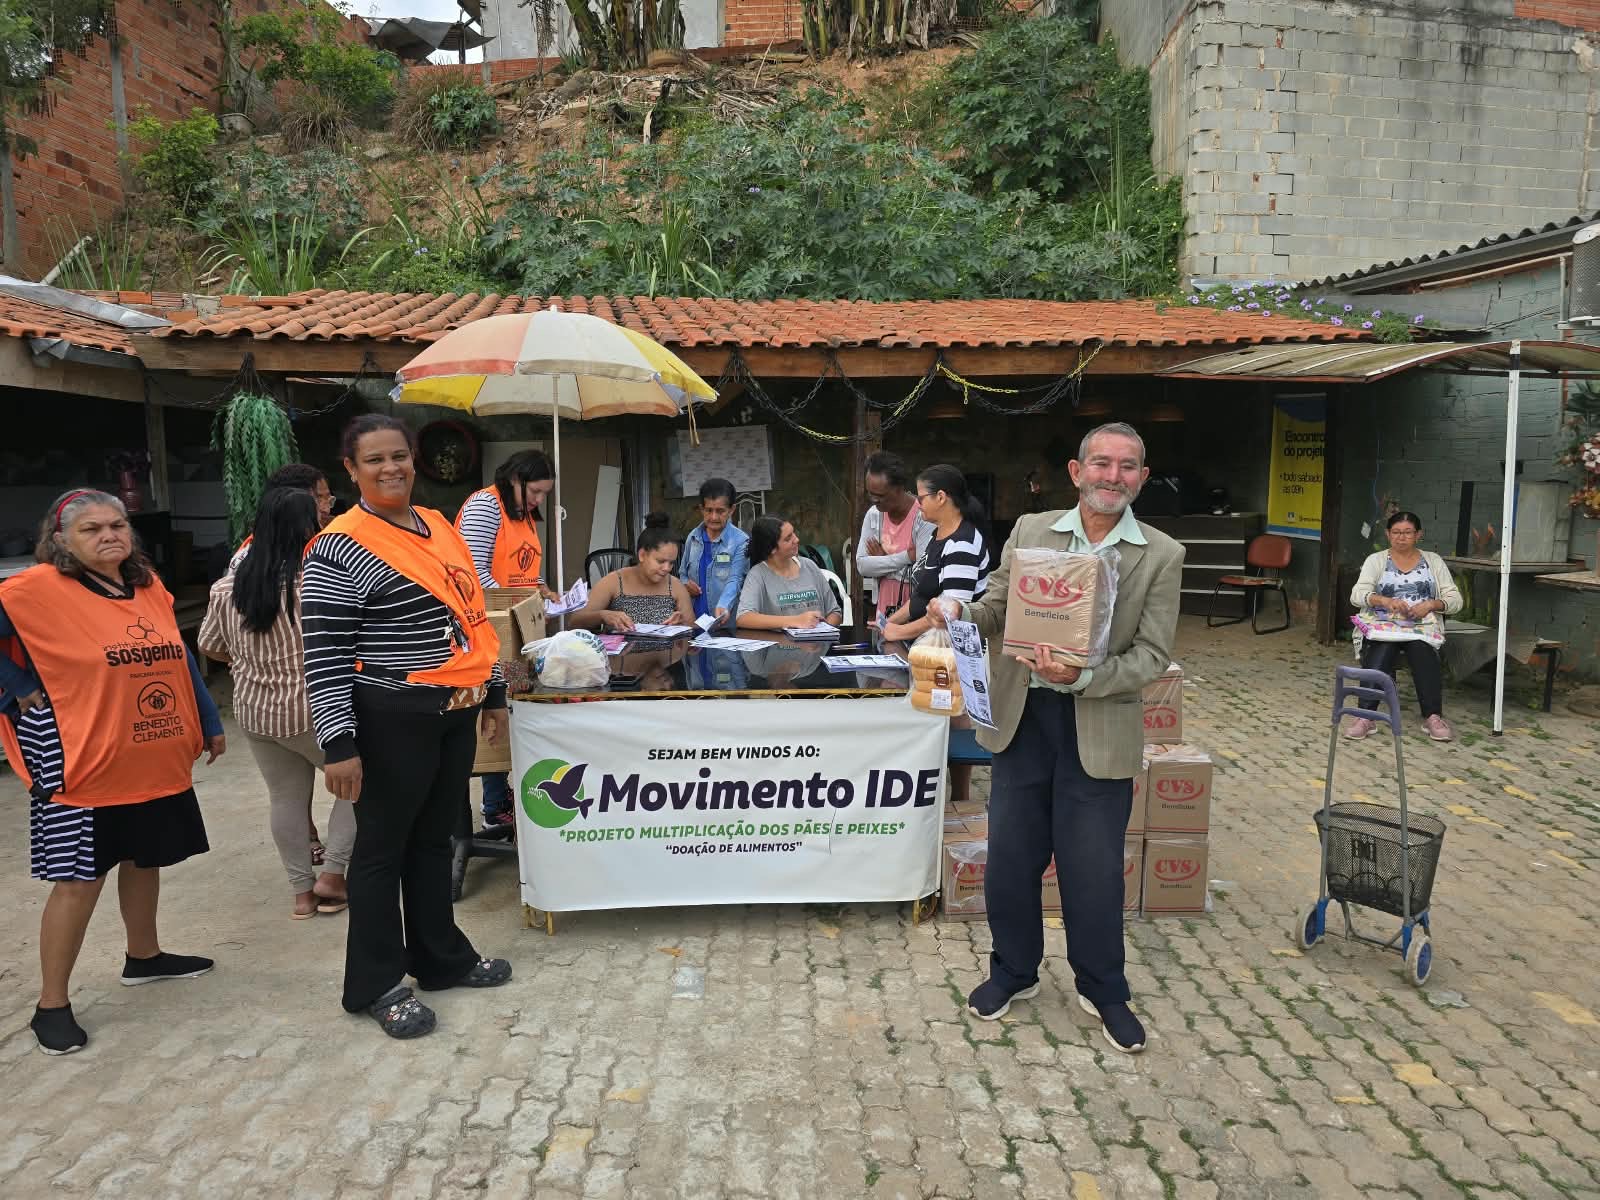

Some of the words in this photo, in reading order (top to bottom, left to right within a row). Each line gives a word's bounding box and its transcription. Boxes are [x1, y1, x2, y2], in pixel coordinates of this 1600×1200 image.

[1284, 446, 1296, 457] do
[1017, 575, 1071, 599] CVS
[1024, 608, 1071, 621] Beneficios
[106, 640, 184, 667] sosgente
[133, 715, 181, 732] BENEDITO
[132, 726, 185, 744] CLEMENTE
[648, 748, 696, 760] SEJAM
[700, 747, 732, 760] BEM
[736, 746, 791, 759] VINDOS
[795, 745, 820, 758] AO:
[598, 767, 855, 812] Movimento
[865, 768, 940, 808] IDE
[1156, 779, 1195, 794] CVS
[640, 820, 755, 840] MULTIPLICAÇÃO
[759, 823, 789, 836] DOS
[794, 819, 830, 835] PÃES
[834, 823, 844, 835] E
[719, 843, 733, 853] DE
[952, 863, 985, 877] CV
[1154, 858, 1193, 873] CVS
